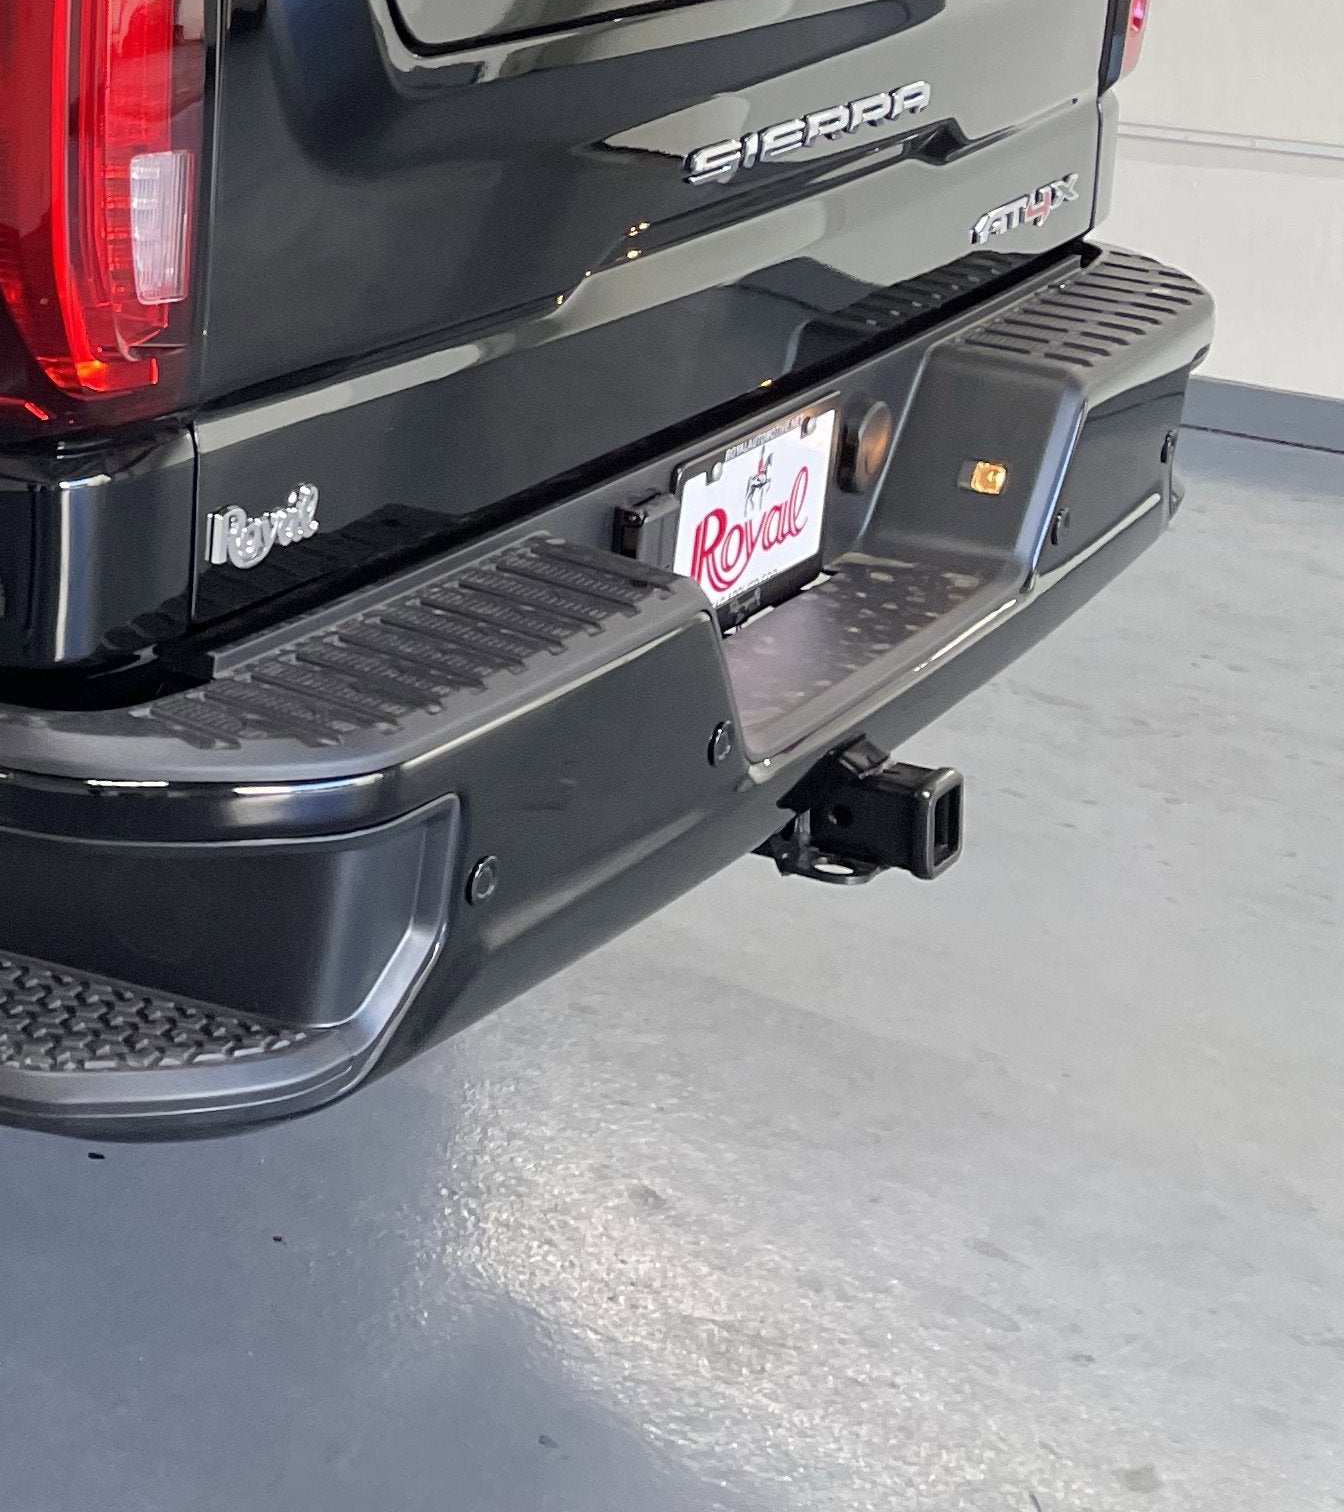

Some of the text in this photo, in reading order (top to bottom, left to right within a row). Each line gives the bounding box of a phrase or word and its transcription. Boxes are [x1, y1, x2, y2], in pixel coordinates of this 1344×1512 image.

[681, 80, 932, 185] SIERRA
[968, 172, 1080, 245] AT4X
[690, 465, 810, 593] Royal
